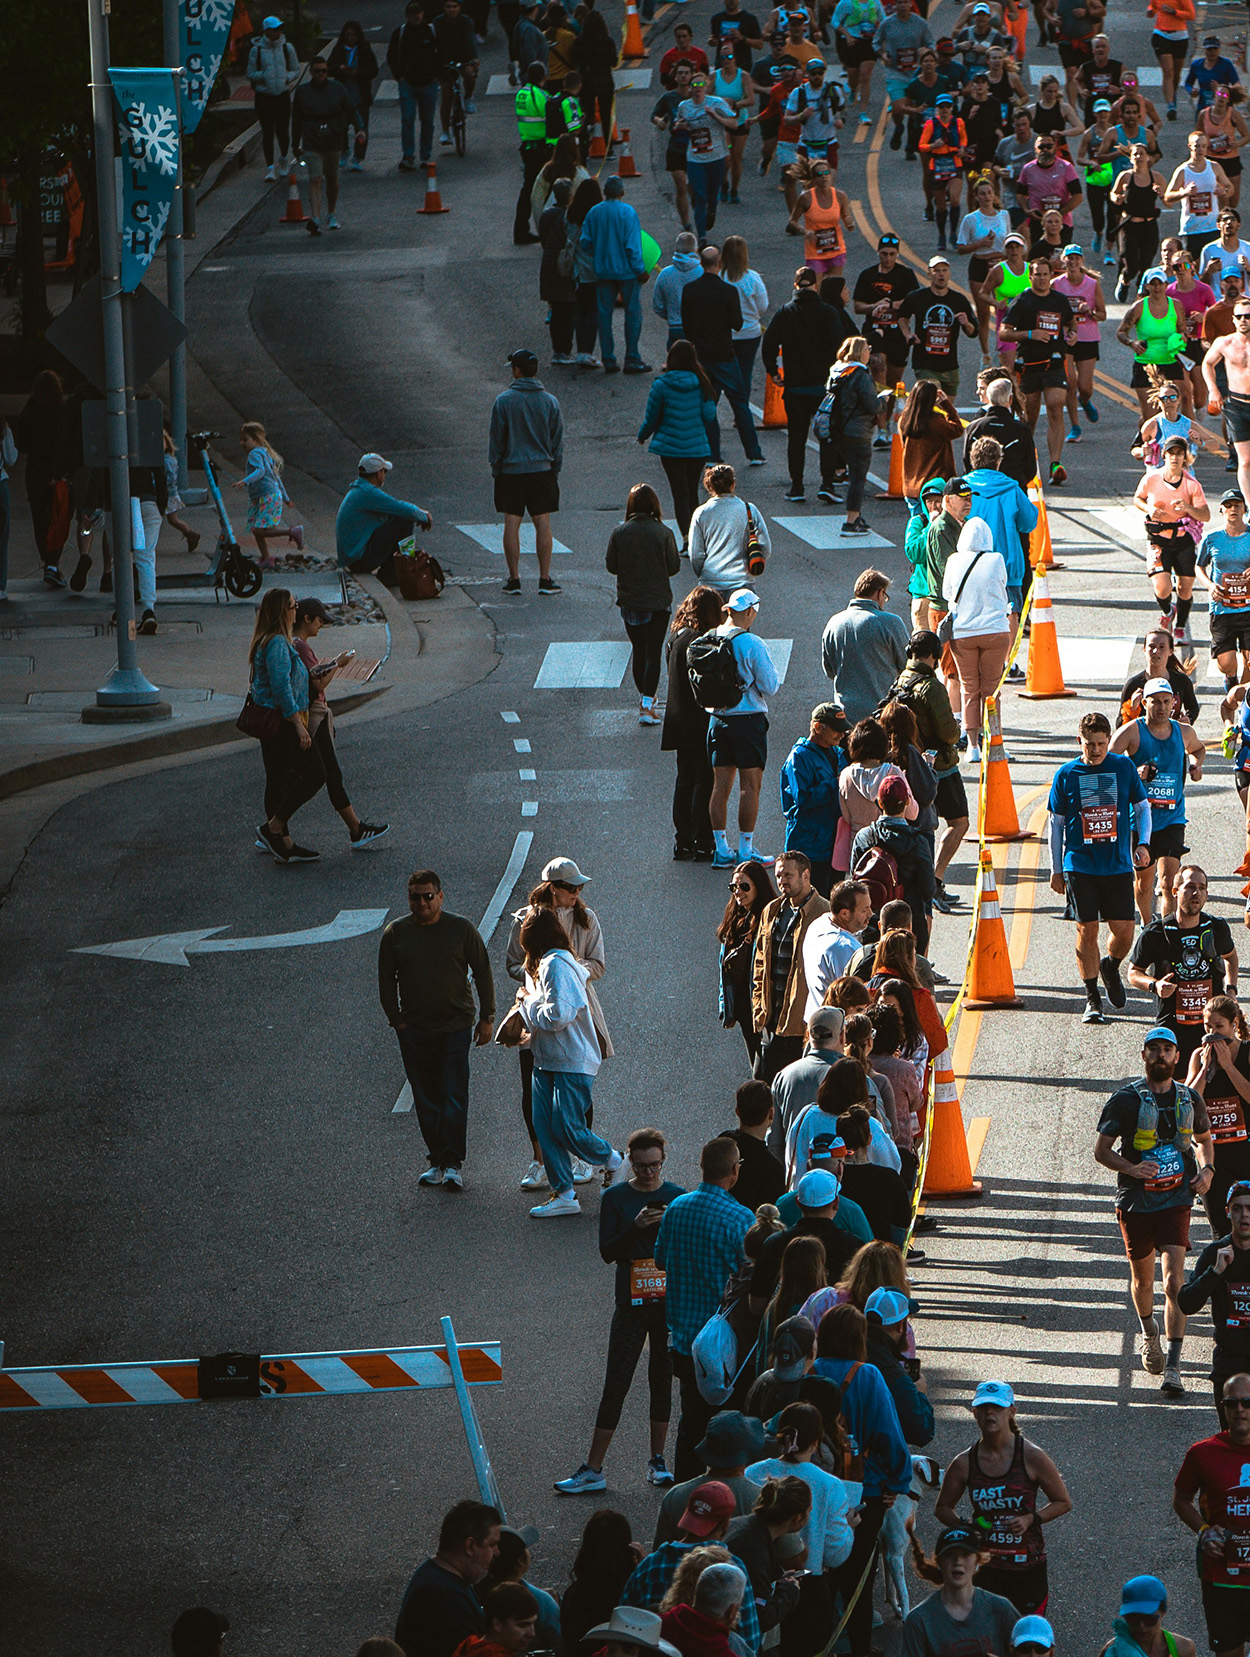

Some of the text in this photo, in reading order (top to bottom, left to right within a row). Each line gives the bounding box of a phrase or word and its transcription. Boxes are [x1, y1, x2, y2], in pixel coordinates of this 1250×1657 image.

[186, 0, 203, 101] ULCH
[121, 89, 135, 99] the
[122, 107, 150, 254] GULCH
[1148, 787, 1174, 796] 20681
[1088, 820, 1112, 831] 3435
[1182, 997, 1207, 1006] 3345
[1212, 1113, 1237, 1125] 2759
[1157, 1161, 1180, 1174] 1226
[636, 1278, 667, 1288] 31687
[972, 1486, 1006, 1501] EAST
[979, 1495, 1023, 1511] NASTY
[1227, 1496, 1240, 1504] St.
[986, 1532, 1023, 1544] 4599
